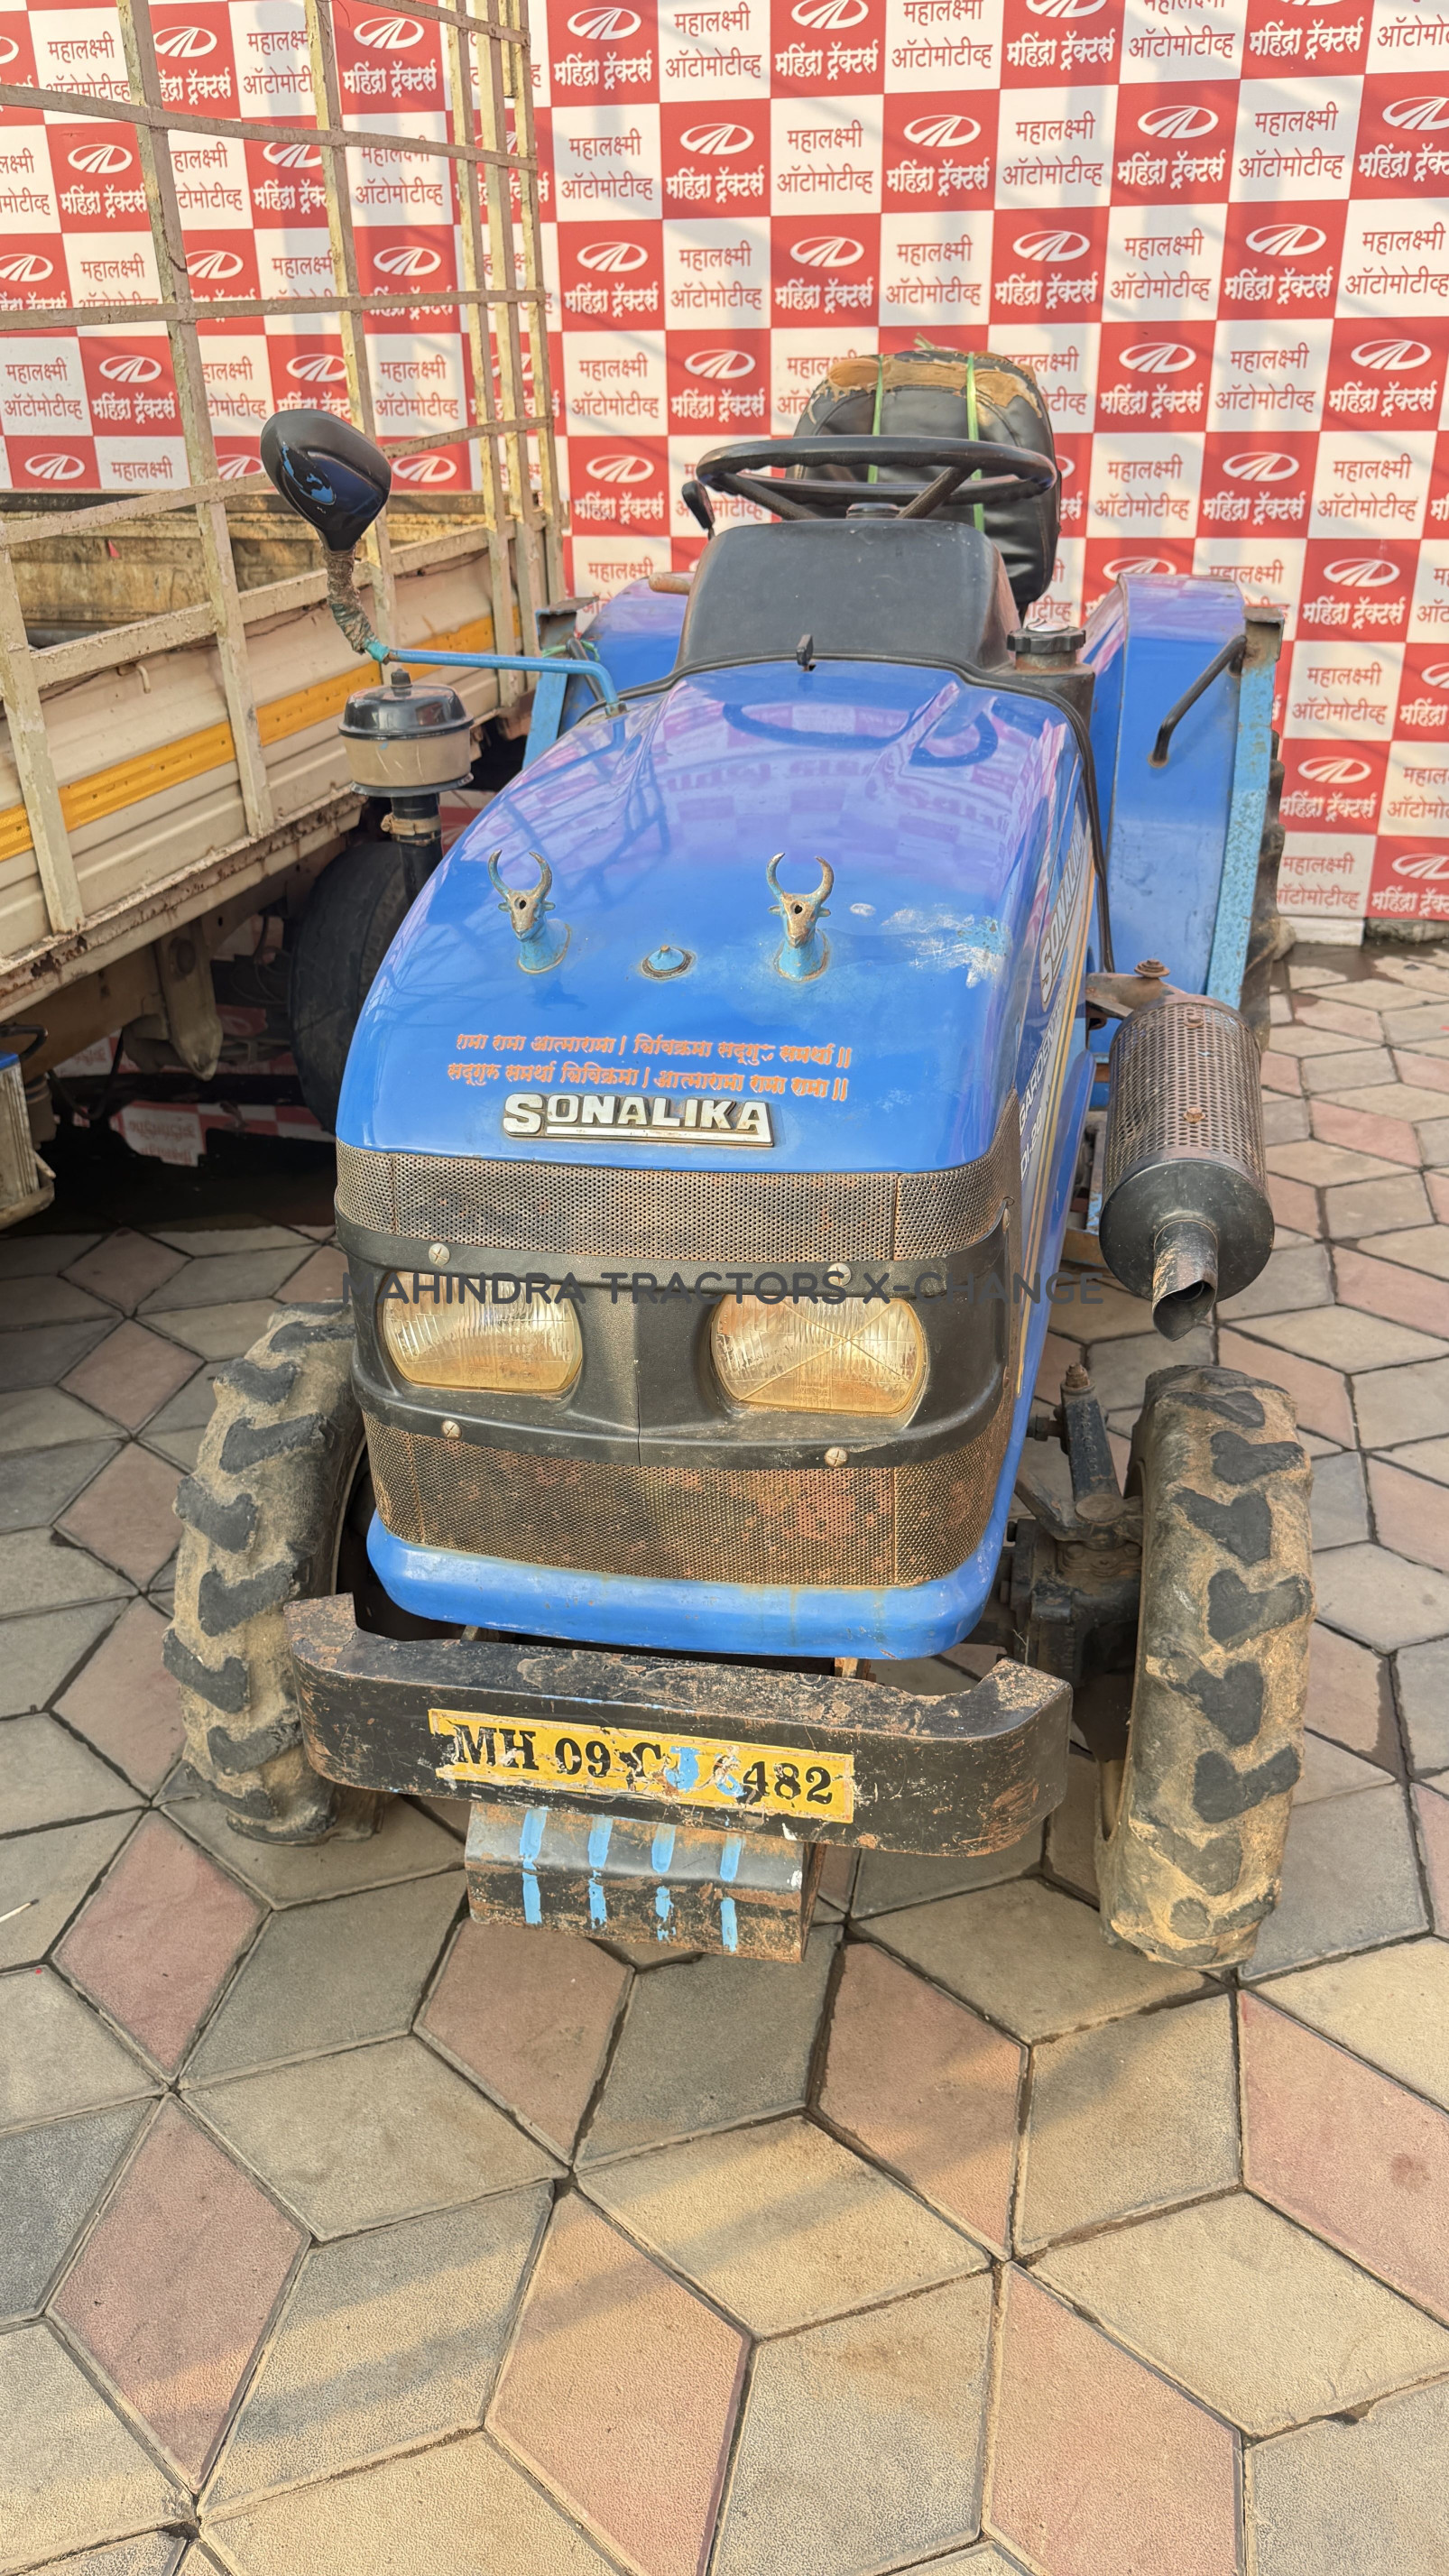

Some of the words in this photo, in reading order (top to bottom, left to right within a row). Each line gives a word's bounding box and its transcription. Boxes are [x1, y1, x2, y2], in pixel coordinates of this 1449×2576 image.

[675, 2, 751, 37] महालक्ष्मी
[47, 32, 114, 63] महालक्ष्मी
[247, 32, 308, 55] महालक्ष्म
[892, 36, 993, 69] ऑटोमोटीव्ह
[1007, 32, 1057, 67] महिंद्रा
[1060, 29, 1115, 70] ट्रॅक्टर्स
[1129, 25, 1235, 58] ऑटोमोटीव्ह
[1250, 20, 1302, 57] महिंद्रा
[1305, 17, 1363, 60] ट्रॅक्टर्स
[554, 52, 599, 87] महिंद्रा
[604, 50, 652, 89] ट्रॅक्टर्स
[666, 47, 761, 79] ऑटोमोटीव्ह
[775, 43, 823, 77] महिंद्रा
[827, 39, 878, 79] ट्रॅक्टर्स
[185, 67, 231, 105] ट्रॅक्टर्स
[244, 65, 313, 94] ऑटोमोटी
[343, 61, 386, 94] महिंद्रा
[390, 59, 437, 97] ट्रॅक्टर्स
[1016, 110, 1094, 145] महालक्ष्मी
[1255, 101, 1338, 137] महालक्ष्मी
[569, 128, 641, 161] महालक्ष्मी
[787, 120, 863, 153] महालक्ष्मी
[171, 142, 227, 172] हालक्ष्मी
[1003, 155, 1104, 188] ऑटोमोटीव्ह
[1118, 152, 1168, 186] महिंद्रा
[1170, 149, 1225, 189] ट्रॅक्टर्स
[1239, 147, 1344, 180] ऑटोमोटीव्ह
[1359, 144, 1412, 179] महिंद्रा
[355, 177, 442, 207] ऑटोमोटीव्ह
[562, 171, 653, 201] ऑटोमोटीव्ह
[666, 167, 712, 199] महिंद्रा
[715, 165, 764, 203] ट्रॅक्टर्स
[778, 163, 873, 194] ऑटोमोटीव्ह
[887, 160, 935, 193] महिंद्रा
[938, 157, 989, 196] ट्रॅक्टर्स
[60, 184, 101, 215] महिंद्रा
[176, 182, 243, 210] टोमोटीव्ह
[253, 180, 295, 210] महिंद्रा
[897, 235, 973, 267] महालक्ष्मी
[1124, 228, 1204, 261] महालक्ष्मी
[1362, 222, 1446, 254] महालक्ष्मी
[80, 253, 144, 282] महालक्ष्मी
[678, 240, 751, 272] महालक्ष्मी
[564, 283, 608, 314] महिंद्रा
[611, 282, 658, 317] ट्रॅक्टर्स
[671, 282, 761, 310] ऑटोमोटीव्ह
[775, 279, 820, 309] महिंद्रा
[825, 277, 873, 313] ट्रॅक्टर्स
[886, 276, 982, 306] ऑटोमोटीव्ह
[995, 273, 1043, 305] महिंद्रा
[1046, 272, 1097, 309] ट्रॅक्टर्स
[1112, 271, 1211, 301] ऑटोमोटीव्ह
[1224, 267, 1275, 301] महिंद्रा
[1277, 266, 1333, 304] ट्रॅक्टर्स
[5, 357, 67, 384] महालक्ष्मी
[202, 356, 253, 383] हालक्ष्मी
[380, 355, 446, 383] महालक्ष्मी
[578, 352, 648, 381] महालक्ष्मी
[1231, 342, 1309, 374] महालक्ष्मी
[4, 393, 82, 420] ऑटोमोटीव्ह
[91, 392, 131, 420] महिंद्रा
[134, 392, 175, 423] ट्रॅक्टर्स
[208, 393, 267, 420] टोमोटीव्ह
[375, 392, 458, 420] ऑटोमोटीव्ह
[572, 391, 659, 419] ऑटोमोटीव्ह
[671, 389, 715, 419] महिंद्रा
[718, 389, 765, 421] ट्रॅक्टर्स
[1101, 384, 1149, 415] महिंद्रा
[1150, 383, 1203, 419] ट्रॅक्टर्स
[1215, 383, 1316, 413] ऑटोमोटीव्ह
[1329, 382, 1380, 413] महिंद्रा
[1380, 381, 1437, 417] ट्रॅक्टर्स
[111, 456, 172, 482] महालक्ष्मी
[1107, 454, 1183, 484] महालक्ष्मी
[1334, 453, 1412, 483] महालक्ष्मी
[574, 492, 615, 520] महिंद्रा
[619, 492, 664, 523] ट्रॅक्टर्स
[1095, 493, 1190, 521] ऑटोमोटीव्ह
[1204, 491, 1251, 522] महिंद्रा
[1253, 492, 1305, 524] ट्रॅक्टर्स
[1318, 492, 1417, 522] ऑटोमोटीव्ह
[1303, 596, 1351, 624] महिंद्रा
[1352, 597, 1405, 629] ट्रॅक्टर्स
[1306, 661, 1382, 688] महालक्ष्मी
[1294, 697, 1388, 725] ऑटोमोटीव्ह
[503, 1094, 773, 1143] SONALIKA
